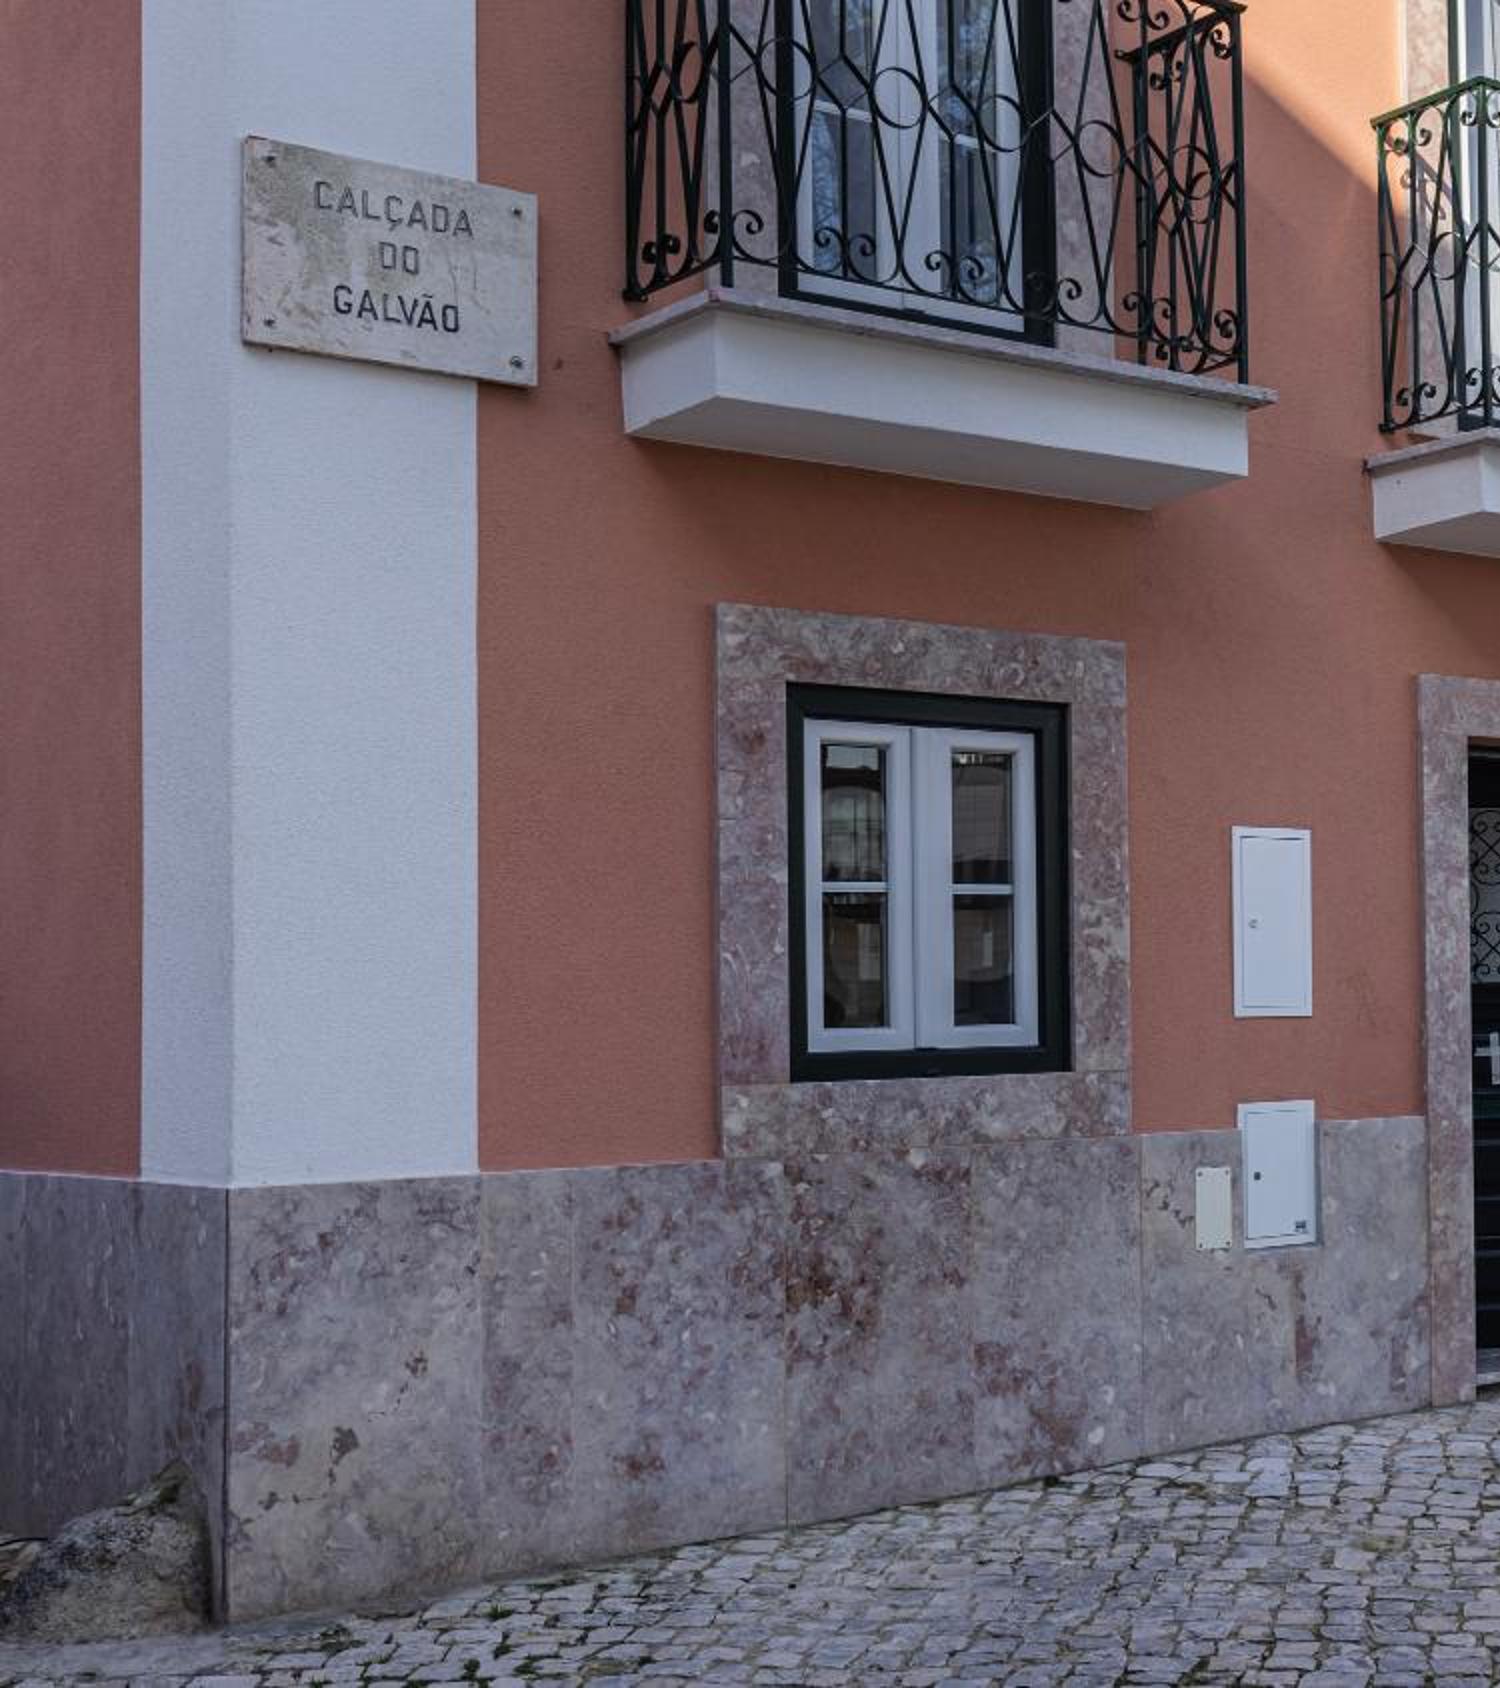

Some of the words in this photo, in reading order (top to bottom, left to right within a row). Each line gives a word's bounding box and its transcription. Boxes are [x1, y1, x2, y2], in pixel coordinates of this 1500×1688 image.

[313, 180, 474, 239] CALÇADA
[378, 241, 420, 275] DO
[332, 284, 460, 333] GALVÃO
